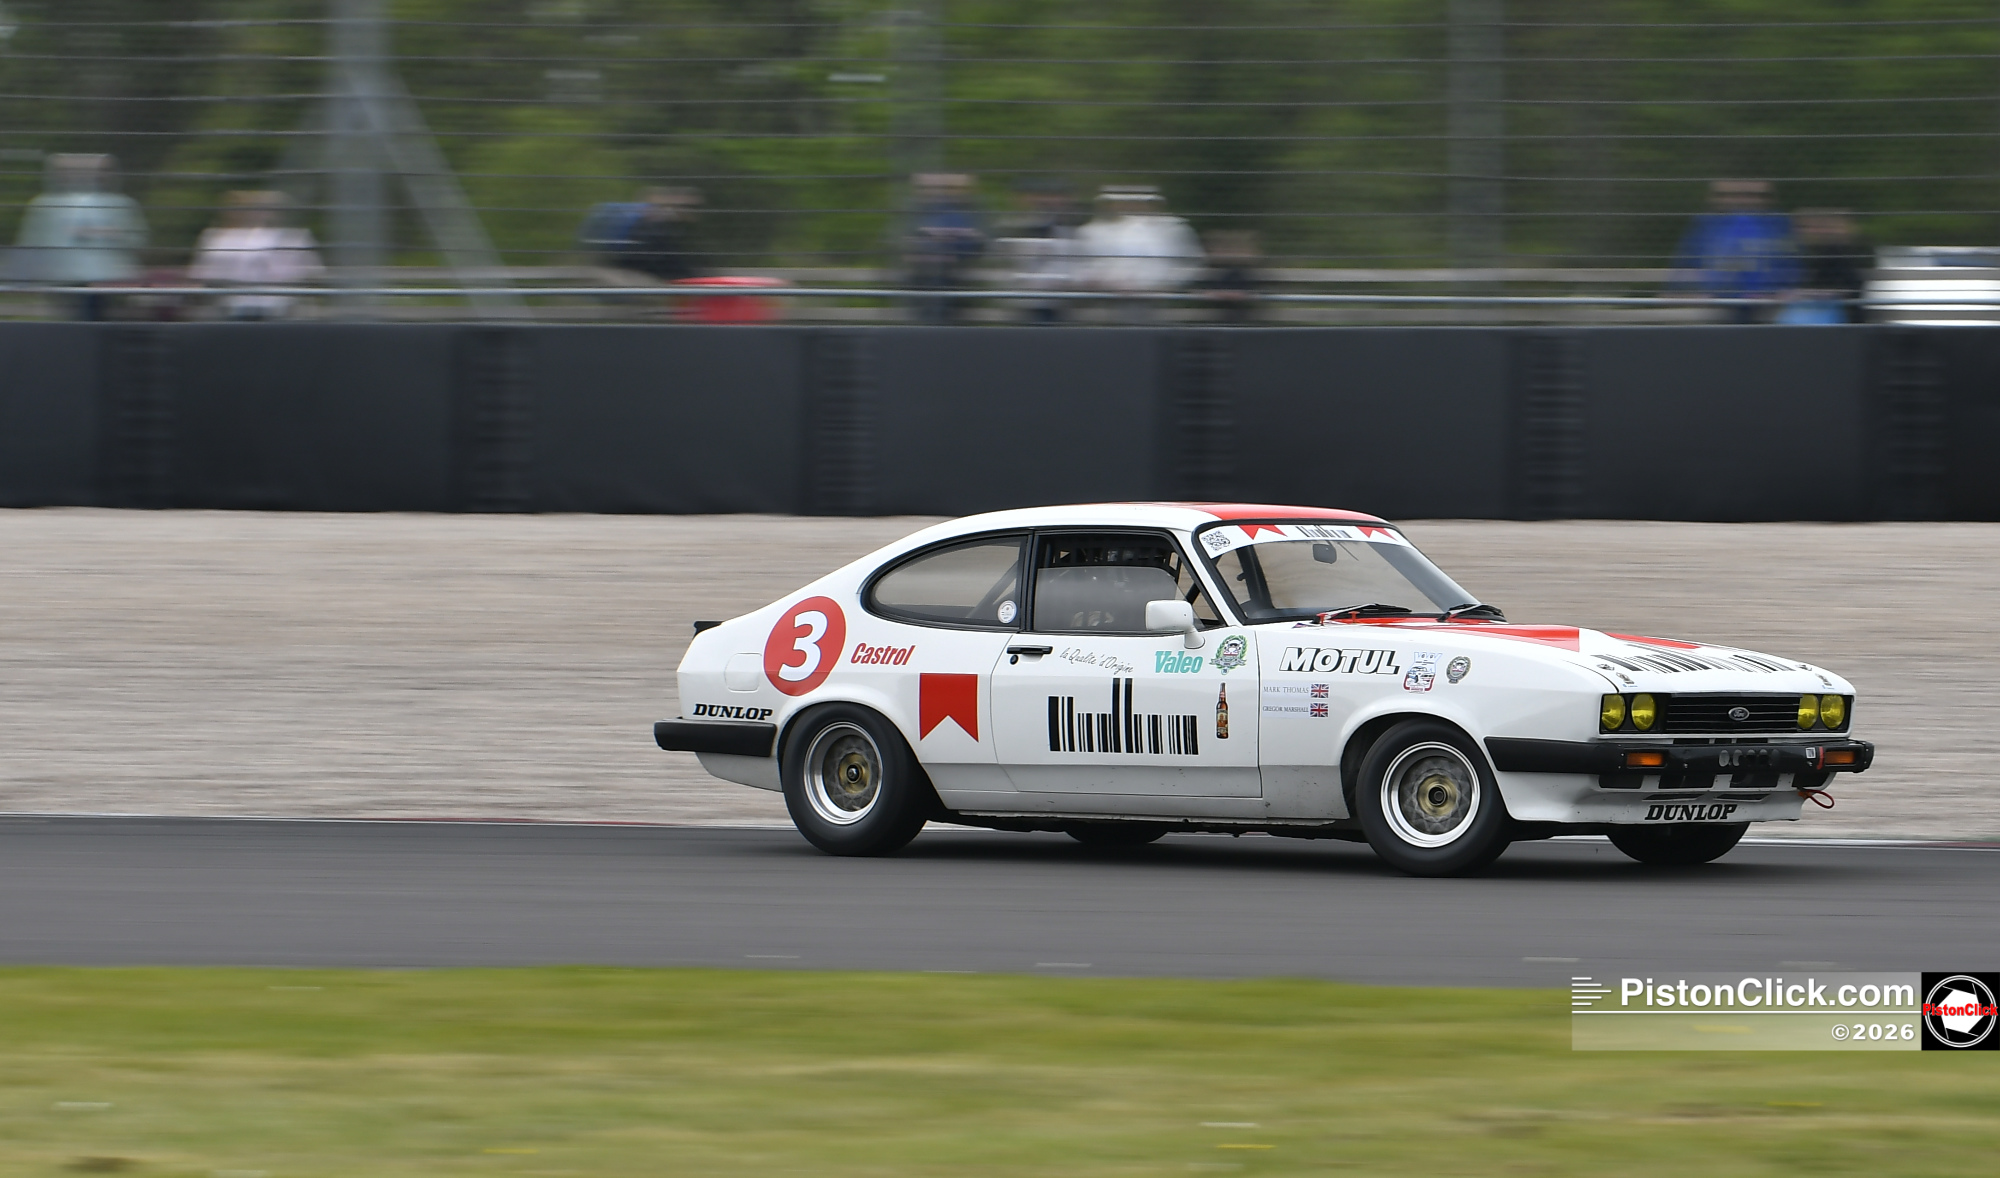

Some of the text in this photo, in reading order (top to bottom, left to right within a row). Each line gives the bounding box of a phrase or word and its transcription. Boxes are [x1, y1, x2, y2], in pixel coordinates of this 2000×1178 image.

[778, 610, 828, 682] 3
[851, 642, 916, 666] Castrol
[1155, 650, 1203, 673] Valeo
[1279, 646, 1400, 675] MOTUL
[1283, 686, 1309, 694] THOMAS
[693, 703, 773, 721] DUNLOP
[1645, 804, 1738, 820] DUNLOP
